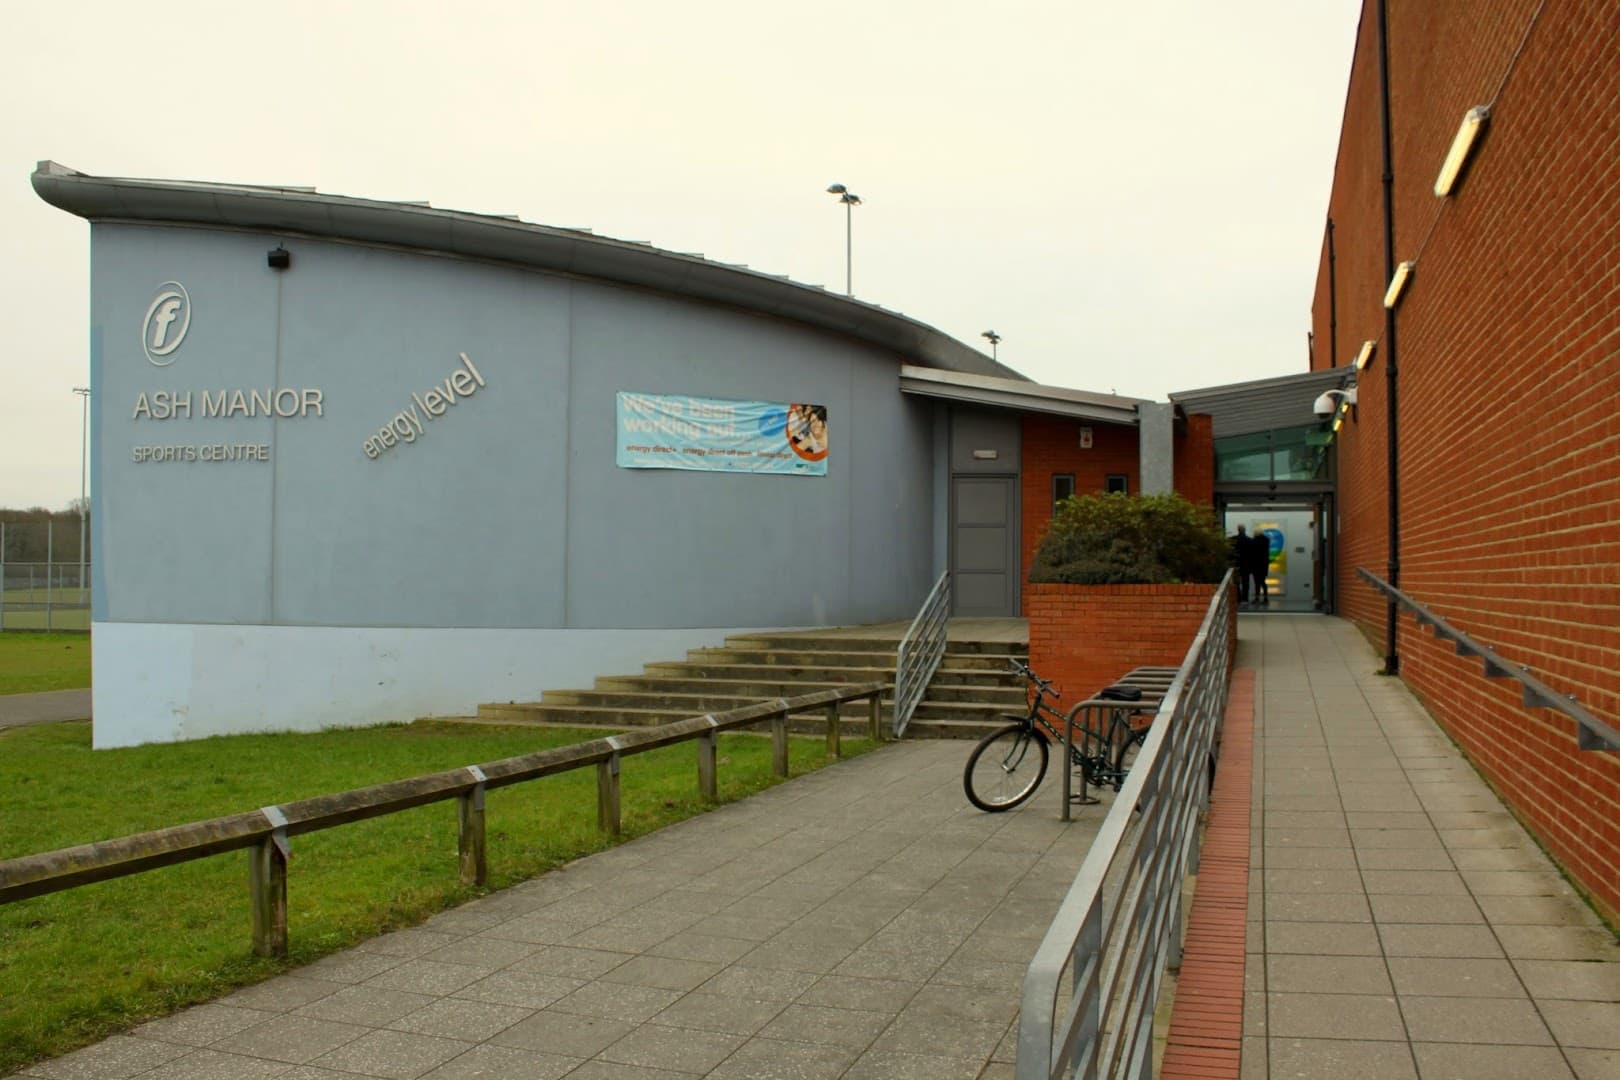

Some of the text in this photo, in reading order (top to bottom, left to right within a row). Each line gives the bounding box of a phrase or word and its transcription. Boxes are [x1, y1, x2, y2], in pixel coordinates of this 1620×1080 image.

[133, 388, 325, 419] ASH MANOR
[362, 352, 486, 460] energy level
[624, 416, 702, 440] working
[132, 444, 270, 463] SPORTS CENTRE
